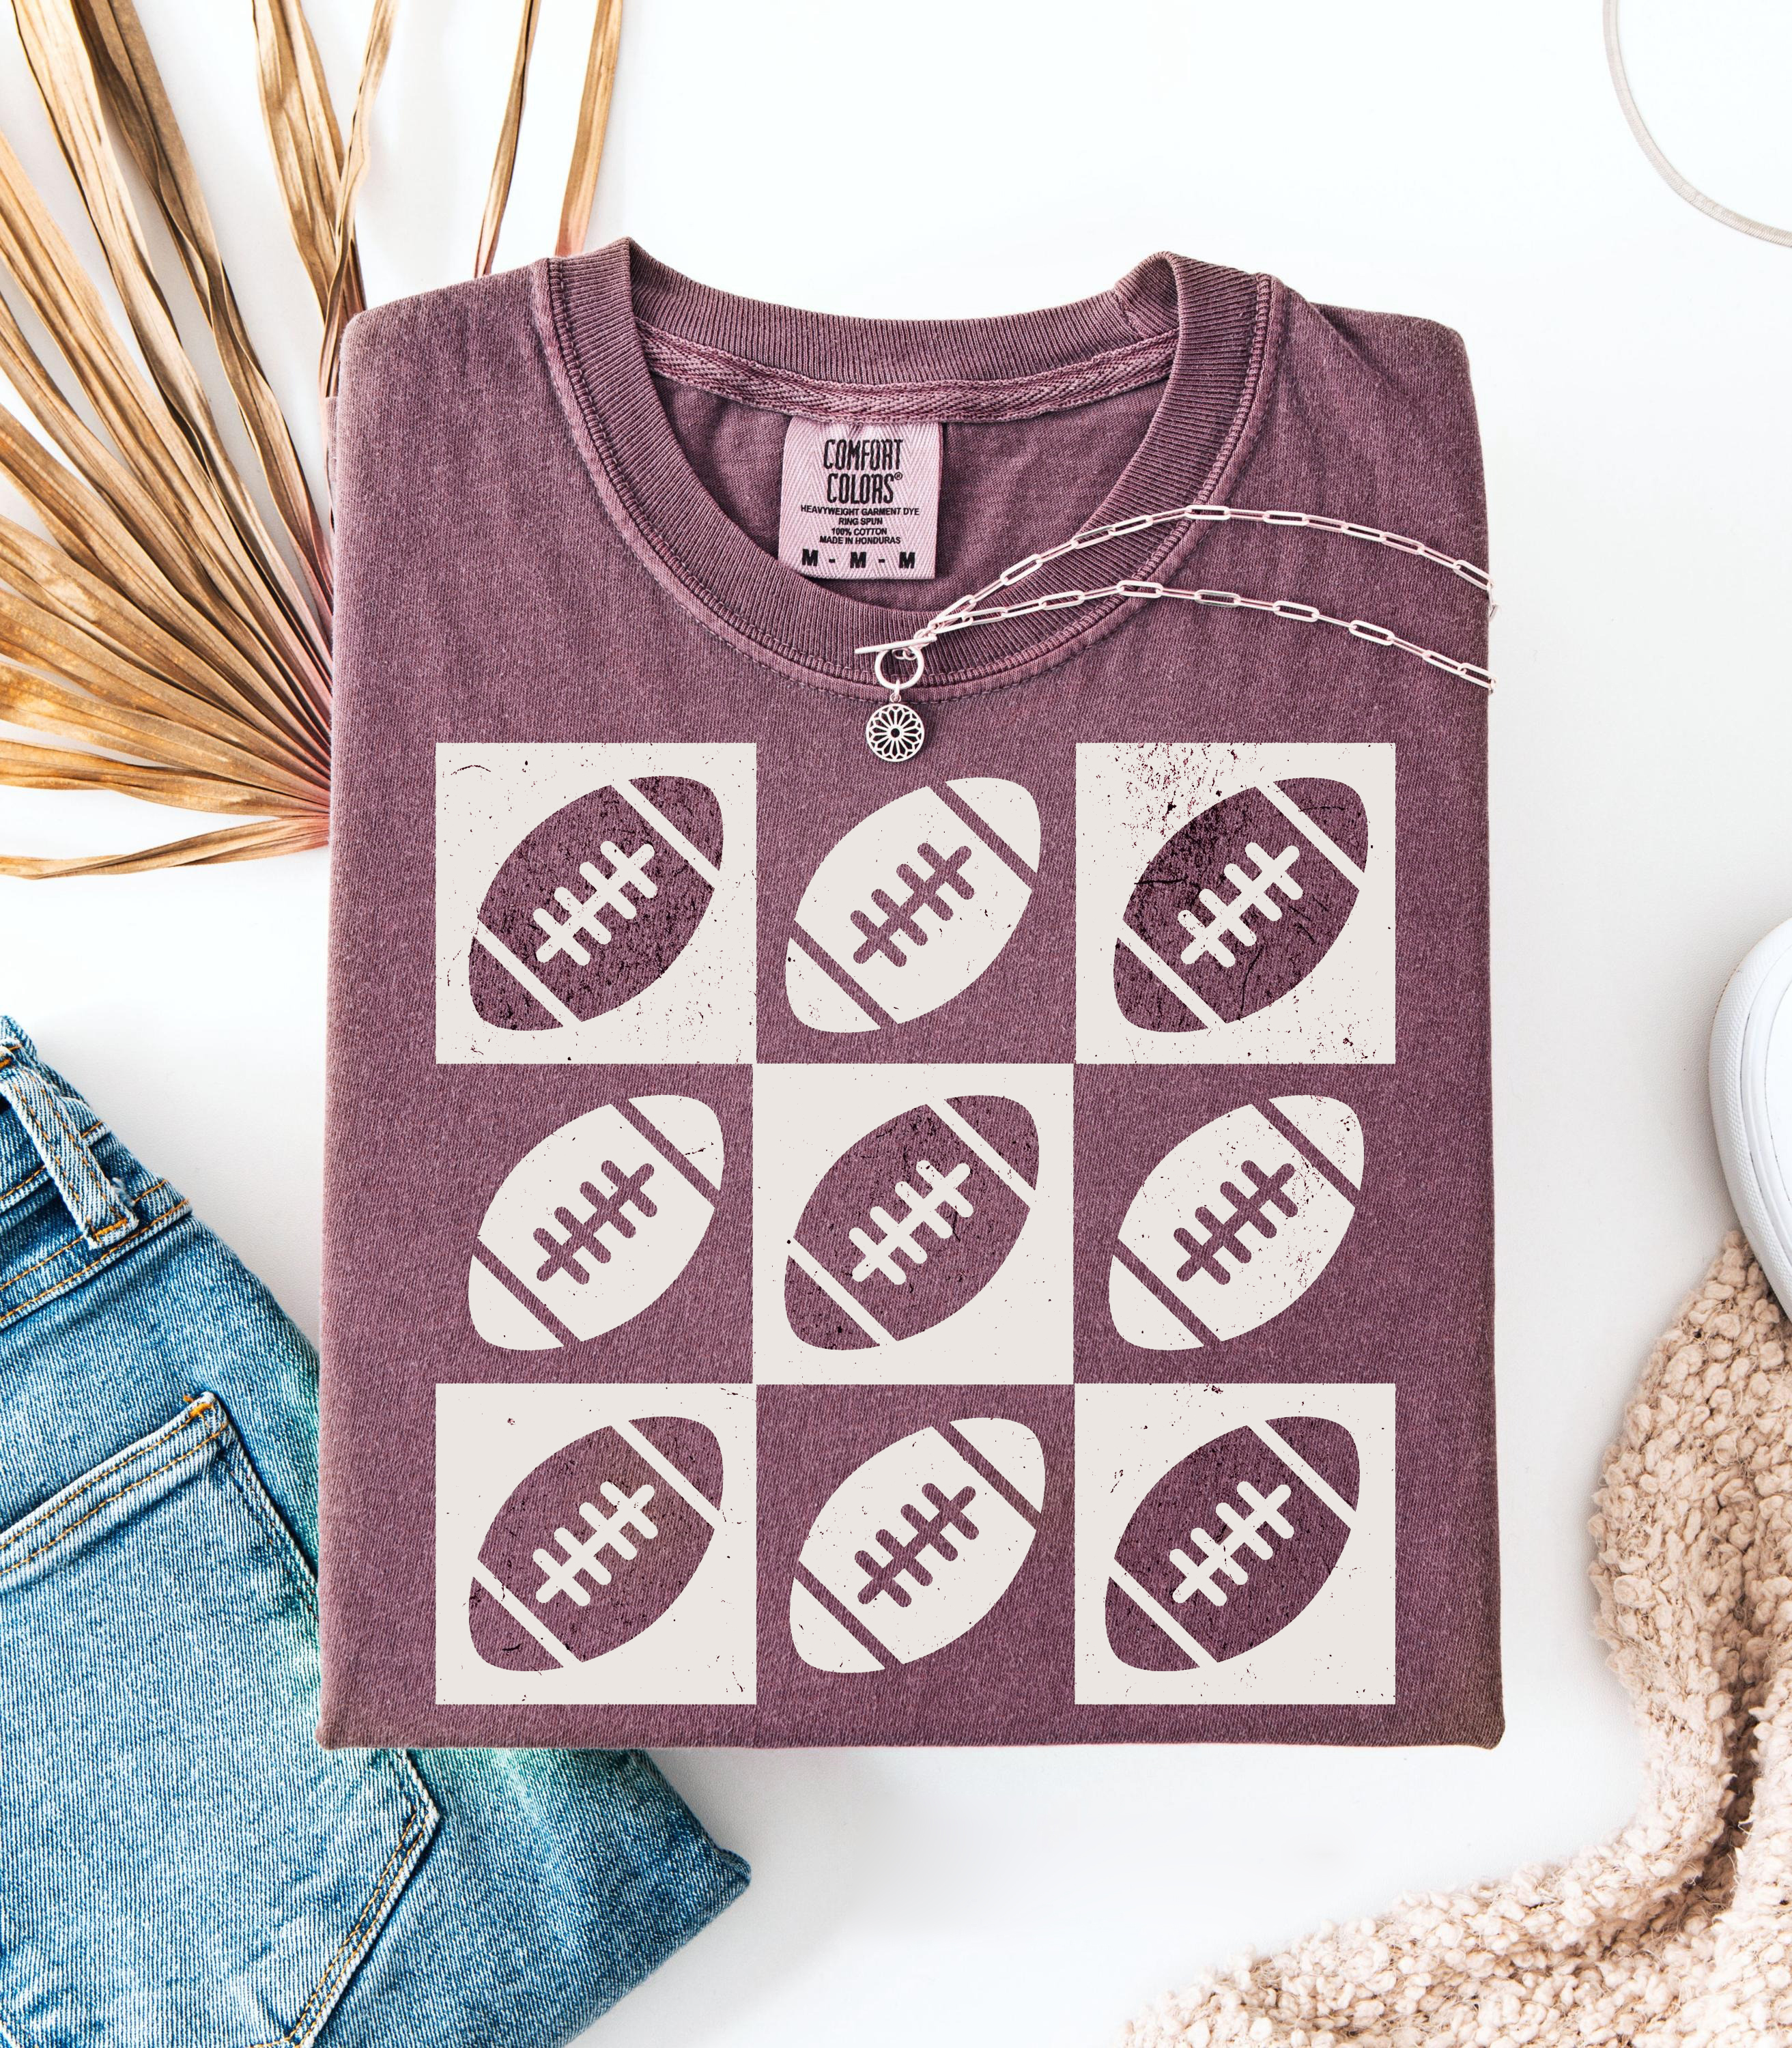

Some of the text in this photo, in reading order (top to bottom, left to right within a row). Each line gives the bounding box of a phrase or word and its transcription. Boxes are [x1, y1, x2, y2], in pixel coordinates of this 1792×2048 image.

[823, 439, 903, 470] COMFORT
[801, 504, 859, 515] HEAVYWEIGHT
[862, 507, 900, 515] GARMENT
[831, 528, 887, 536] 100% COTTON
[819, 536, 843, 544] MADE
[801, 549, 819, 567] M
[850, 552, 867, 568] M
[898, 552, 915, 569] M
